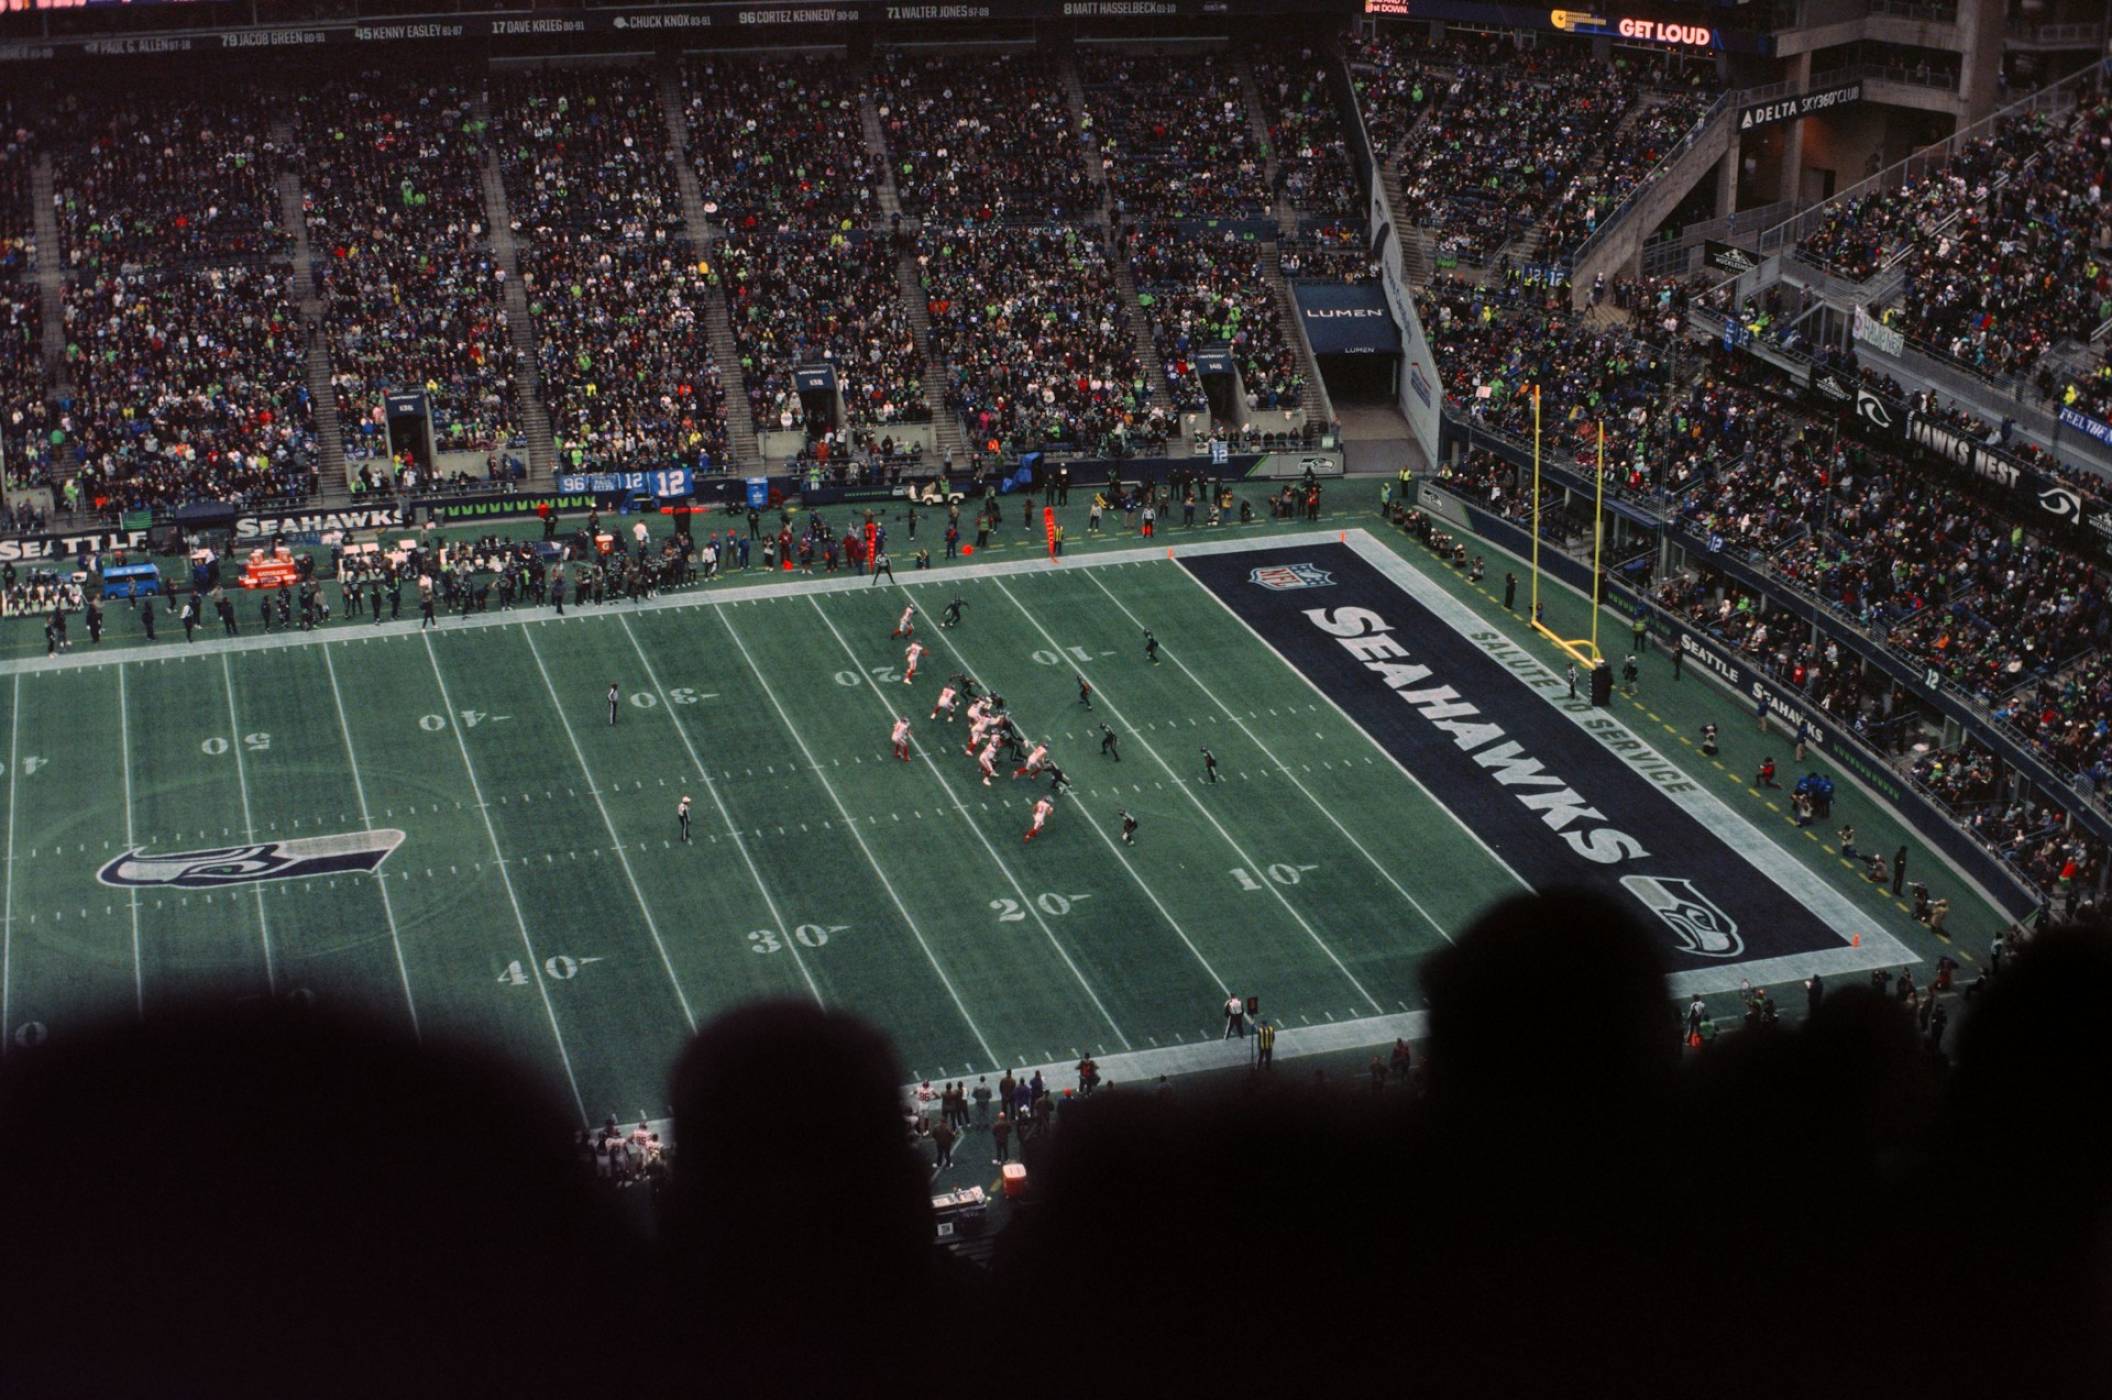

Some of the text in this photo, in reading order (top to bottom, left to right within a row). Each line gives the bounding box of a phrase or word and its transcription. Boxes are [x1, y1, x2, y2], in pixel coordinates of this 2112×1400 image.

[739, 11, 756, 24] 96
[757, 10, 791, 24] CORTEZ
[793, 9, 835, 22] KENNEDY
[886, 7, 900, 19] 71
[901, 6, 937, 19] WALTER
[938, 5, 967, 18] JONES
[1073, 3, 1098, 15] MATT
[1100, 2, 1156, 14] HASSELBECK
[491, 21, 506, 34] 17
[507, 20, 531, 33] DAVE
[532, 19, 562, 32] KRIEG
[630, 15, 662, 29] CHUCK
[664, 14, 689, 27] KNOX
[222, 34, 237, 47] 79
[239, 32, 269, 46] JACOB
[271, 31, 302, 45] GREEN
[355, 27, 371, 40] 45
[373, 26, 405, 40] KENNY
[407, 24, 441, 38] EASLEY
[1619, 18, 1653, 39] GET
[1656, 23, 1710, 46] LOUD
[139, 39, 169, 53] ALLEN
[1755, 101, 1797, 123] DELTA
[1837, 86, 1860, 103] CLUB
[1307, 308, 1384, 318] LUMEN
[1344, 346, 1376, 354] LUMEN
[1212, 449, 1228, 465] 12
[1974, 448, 2021, 489] NEST
[563, 477, 585, 492] 96
[625, 473, 643, 490] 12
[657, 470, 685, 496] 12
[1710, 535, 1723, 553] 12
[1680, 633, 1739, 683] SEATTLE
[1925, 668, 1939, 690] 12
[1471, 630, 1562, 688] SALUTE
[1584, 718, 1697, 794] SERVICE
[1300, 606, 1651, 864] SEAHAWKS
